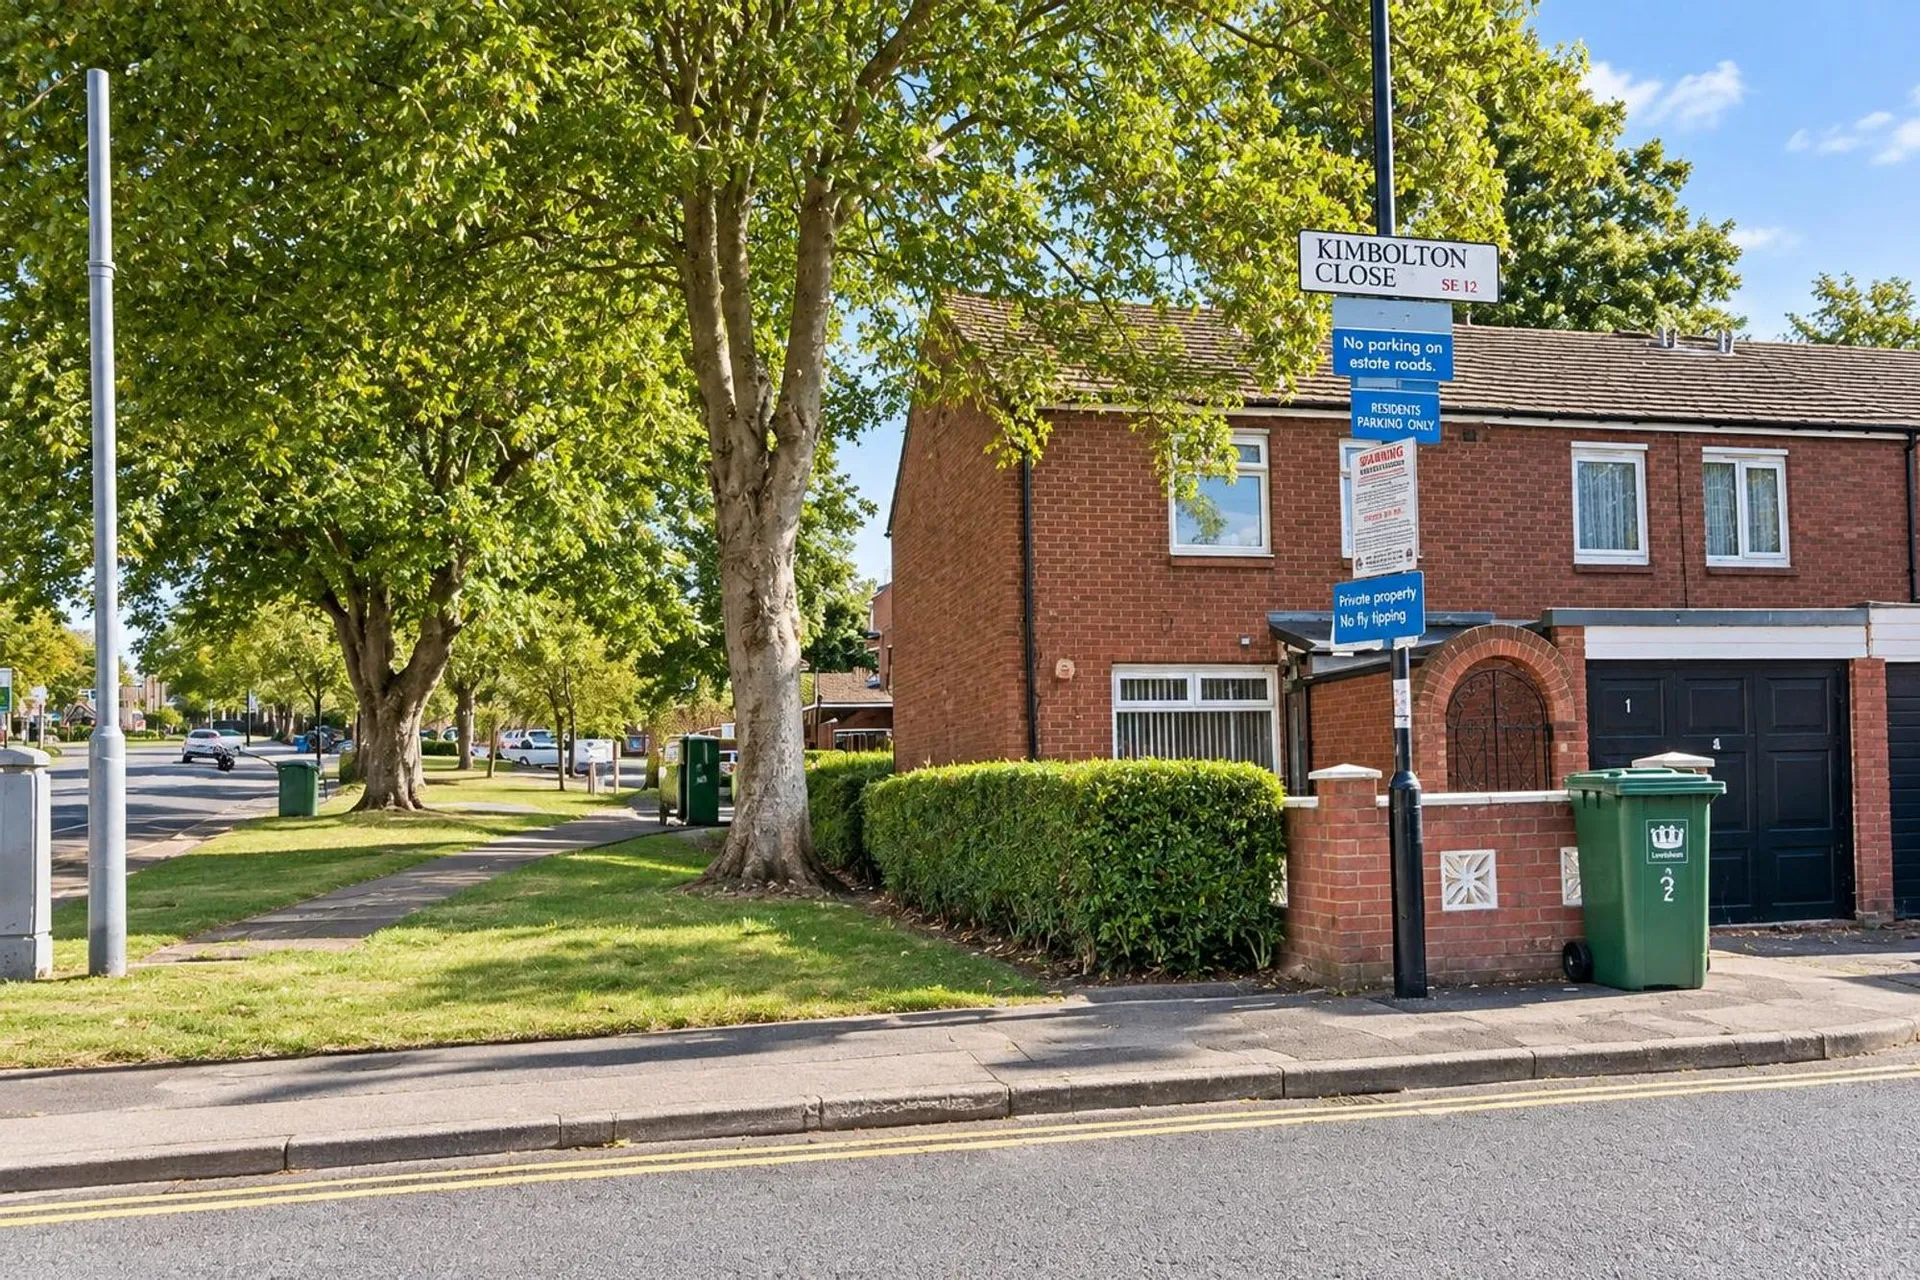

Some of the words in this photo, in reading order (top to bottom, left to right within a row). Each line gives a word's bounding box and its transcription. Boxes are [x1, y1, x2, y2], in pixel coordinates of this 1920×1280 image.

[1317, 238, 1467, 268] KIMBOLTON
[1315, 262, 1397, 287] CLOSE
[1343, 336, 1364, 350] No
[1368, 337, 1421, 356] parking
[1425, 343, 1443, 354] on
[1349, 356, 1390, 369] estate
[1395, 357, 1436, 372] roads.
[1371, 402, 1421, 416] RESIDENTS
[1407, 419, 1435, 431] ONLY
[1339, 593, 1371, 607] Private
[1374, 586, 1417, 607] property
[1340, 613, 1354, 628] No
[1357, 611, 1369, 629] fly
[1372, 608, 1406, 627] tipping
[1625, 698, 1631, 713] 1
